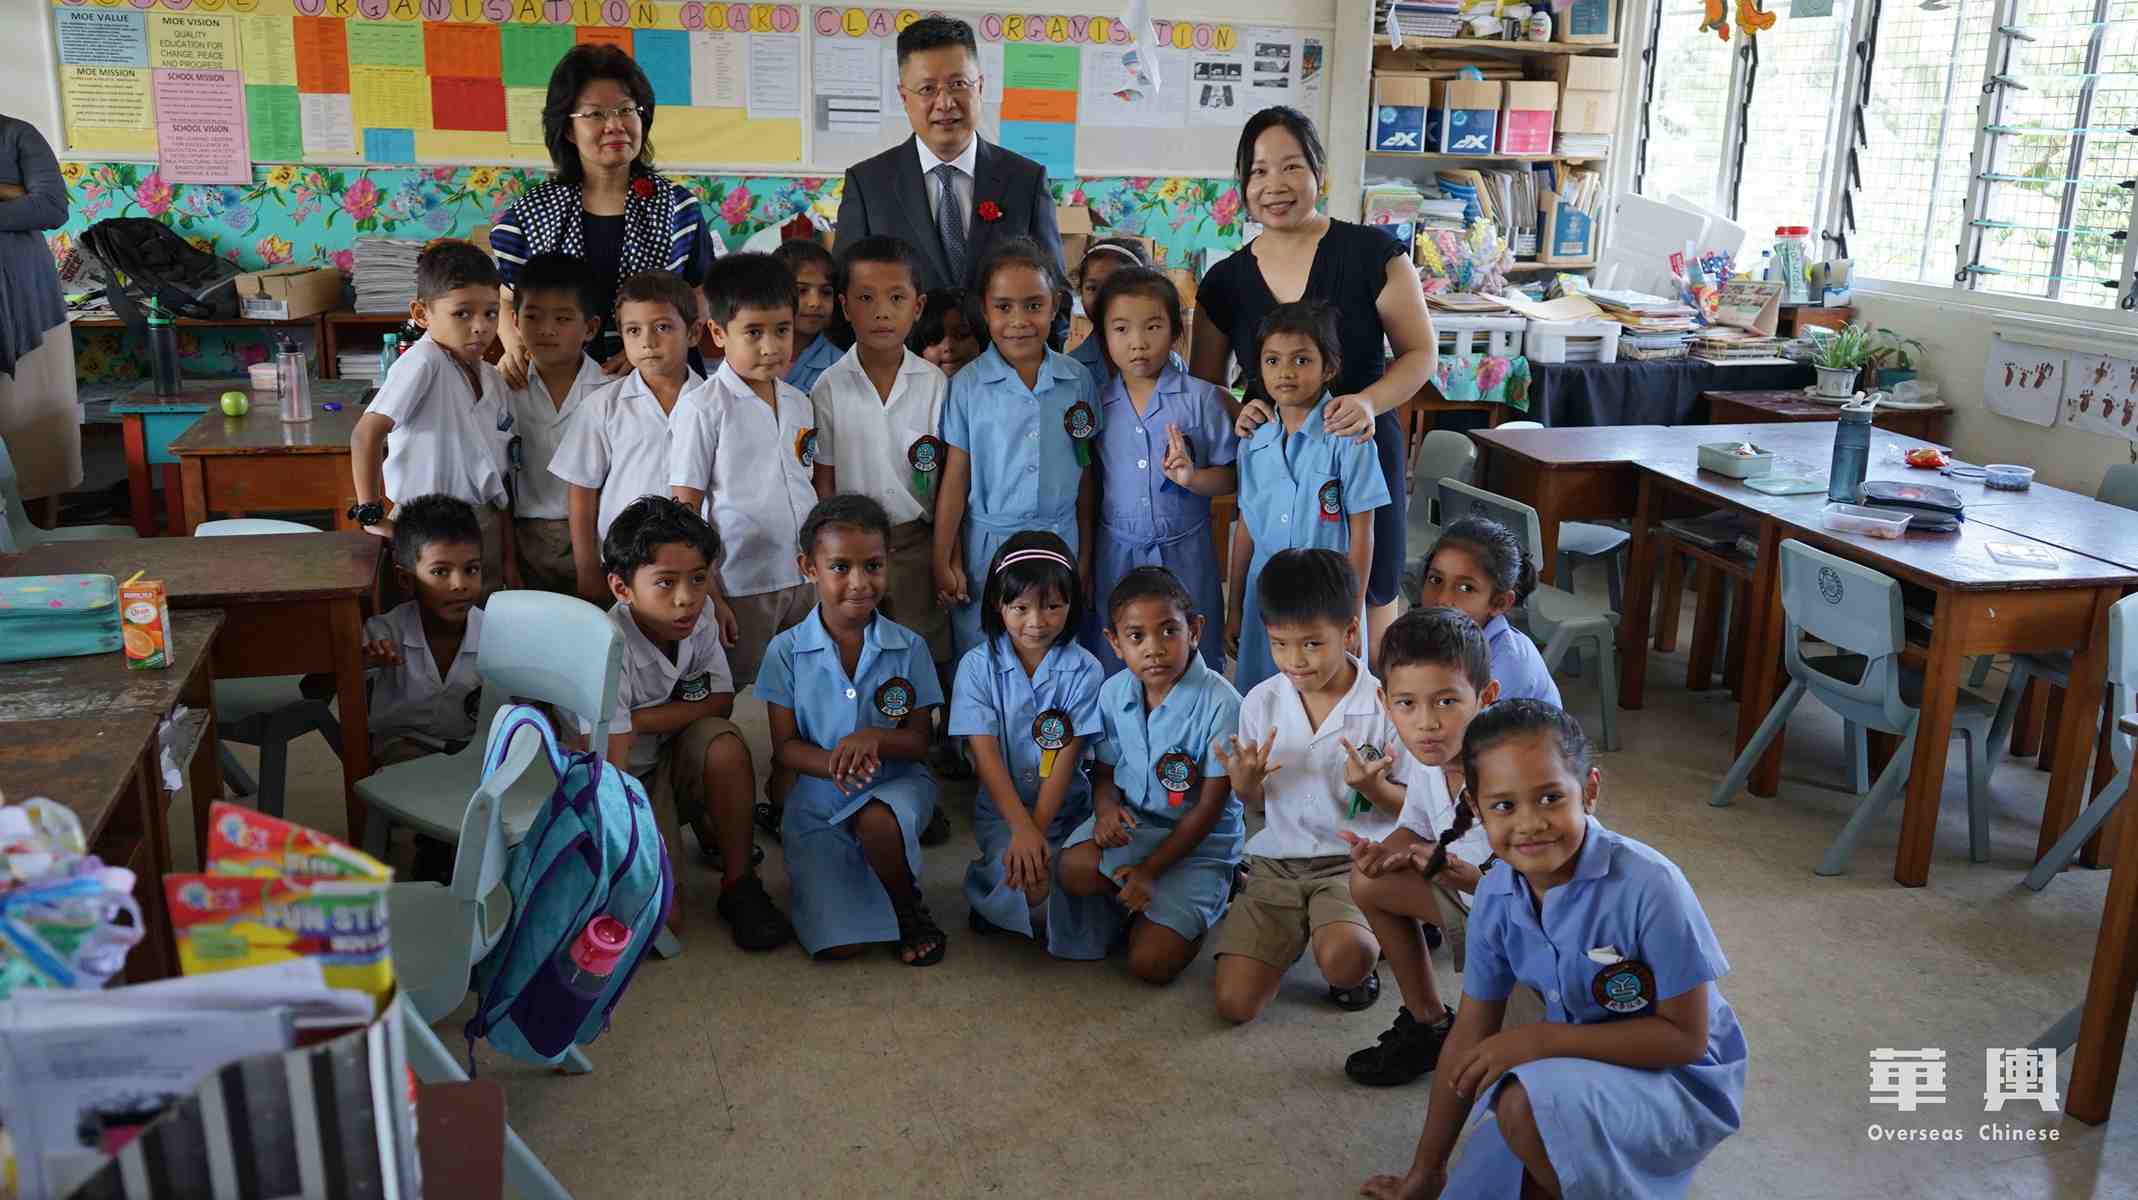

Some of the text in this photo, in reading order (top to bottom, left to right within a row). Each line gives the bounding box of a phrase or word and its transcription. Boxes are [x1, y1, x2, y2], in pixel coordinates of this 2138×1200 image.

[71, 12, 129, 23] MOE VALUE
[161, 16, 220, 27] MOE VISION
[687, 4, 793, 30] BOARD
[174, 30, 207, 38] QUALITY
[986, 15, 1230, 48] ORGANISTION
[159, 39, 224, 50] EDUCATION FOR
[76, 67, 136, 78] MOE MISSION
[167, 71, 225, 82] SCHOOL MISSION
[172, 124, 230, 134] SCHOOL VISION
